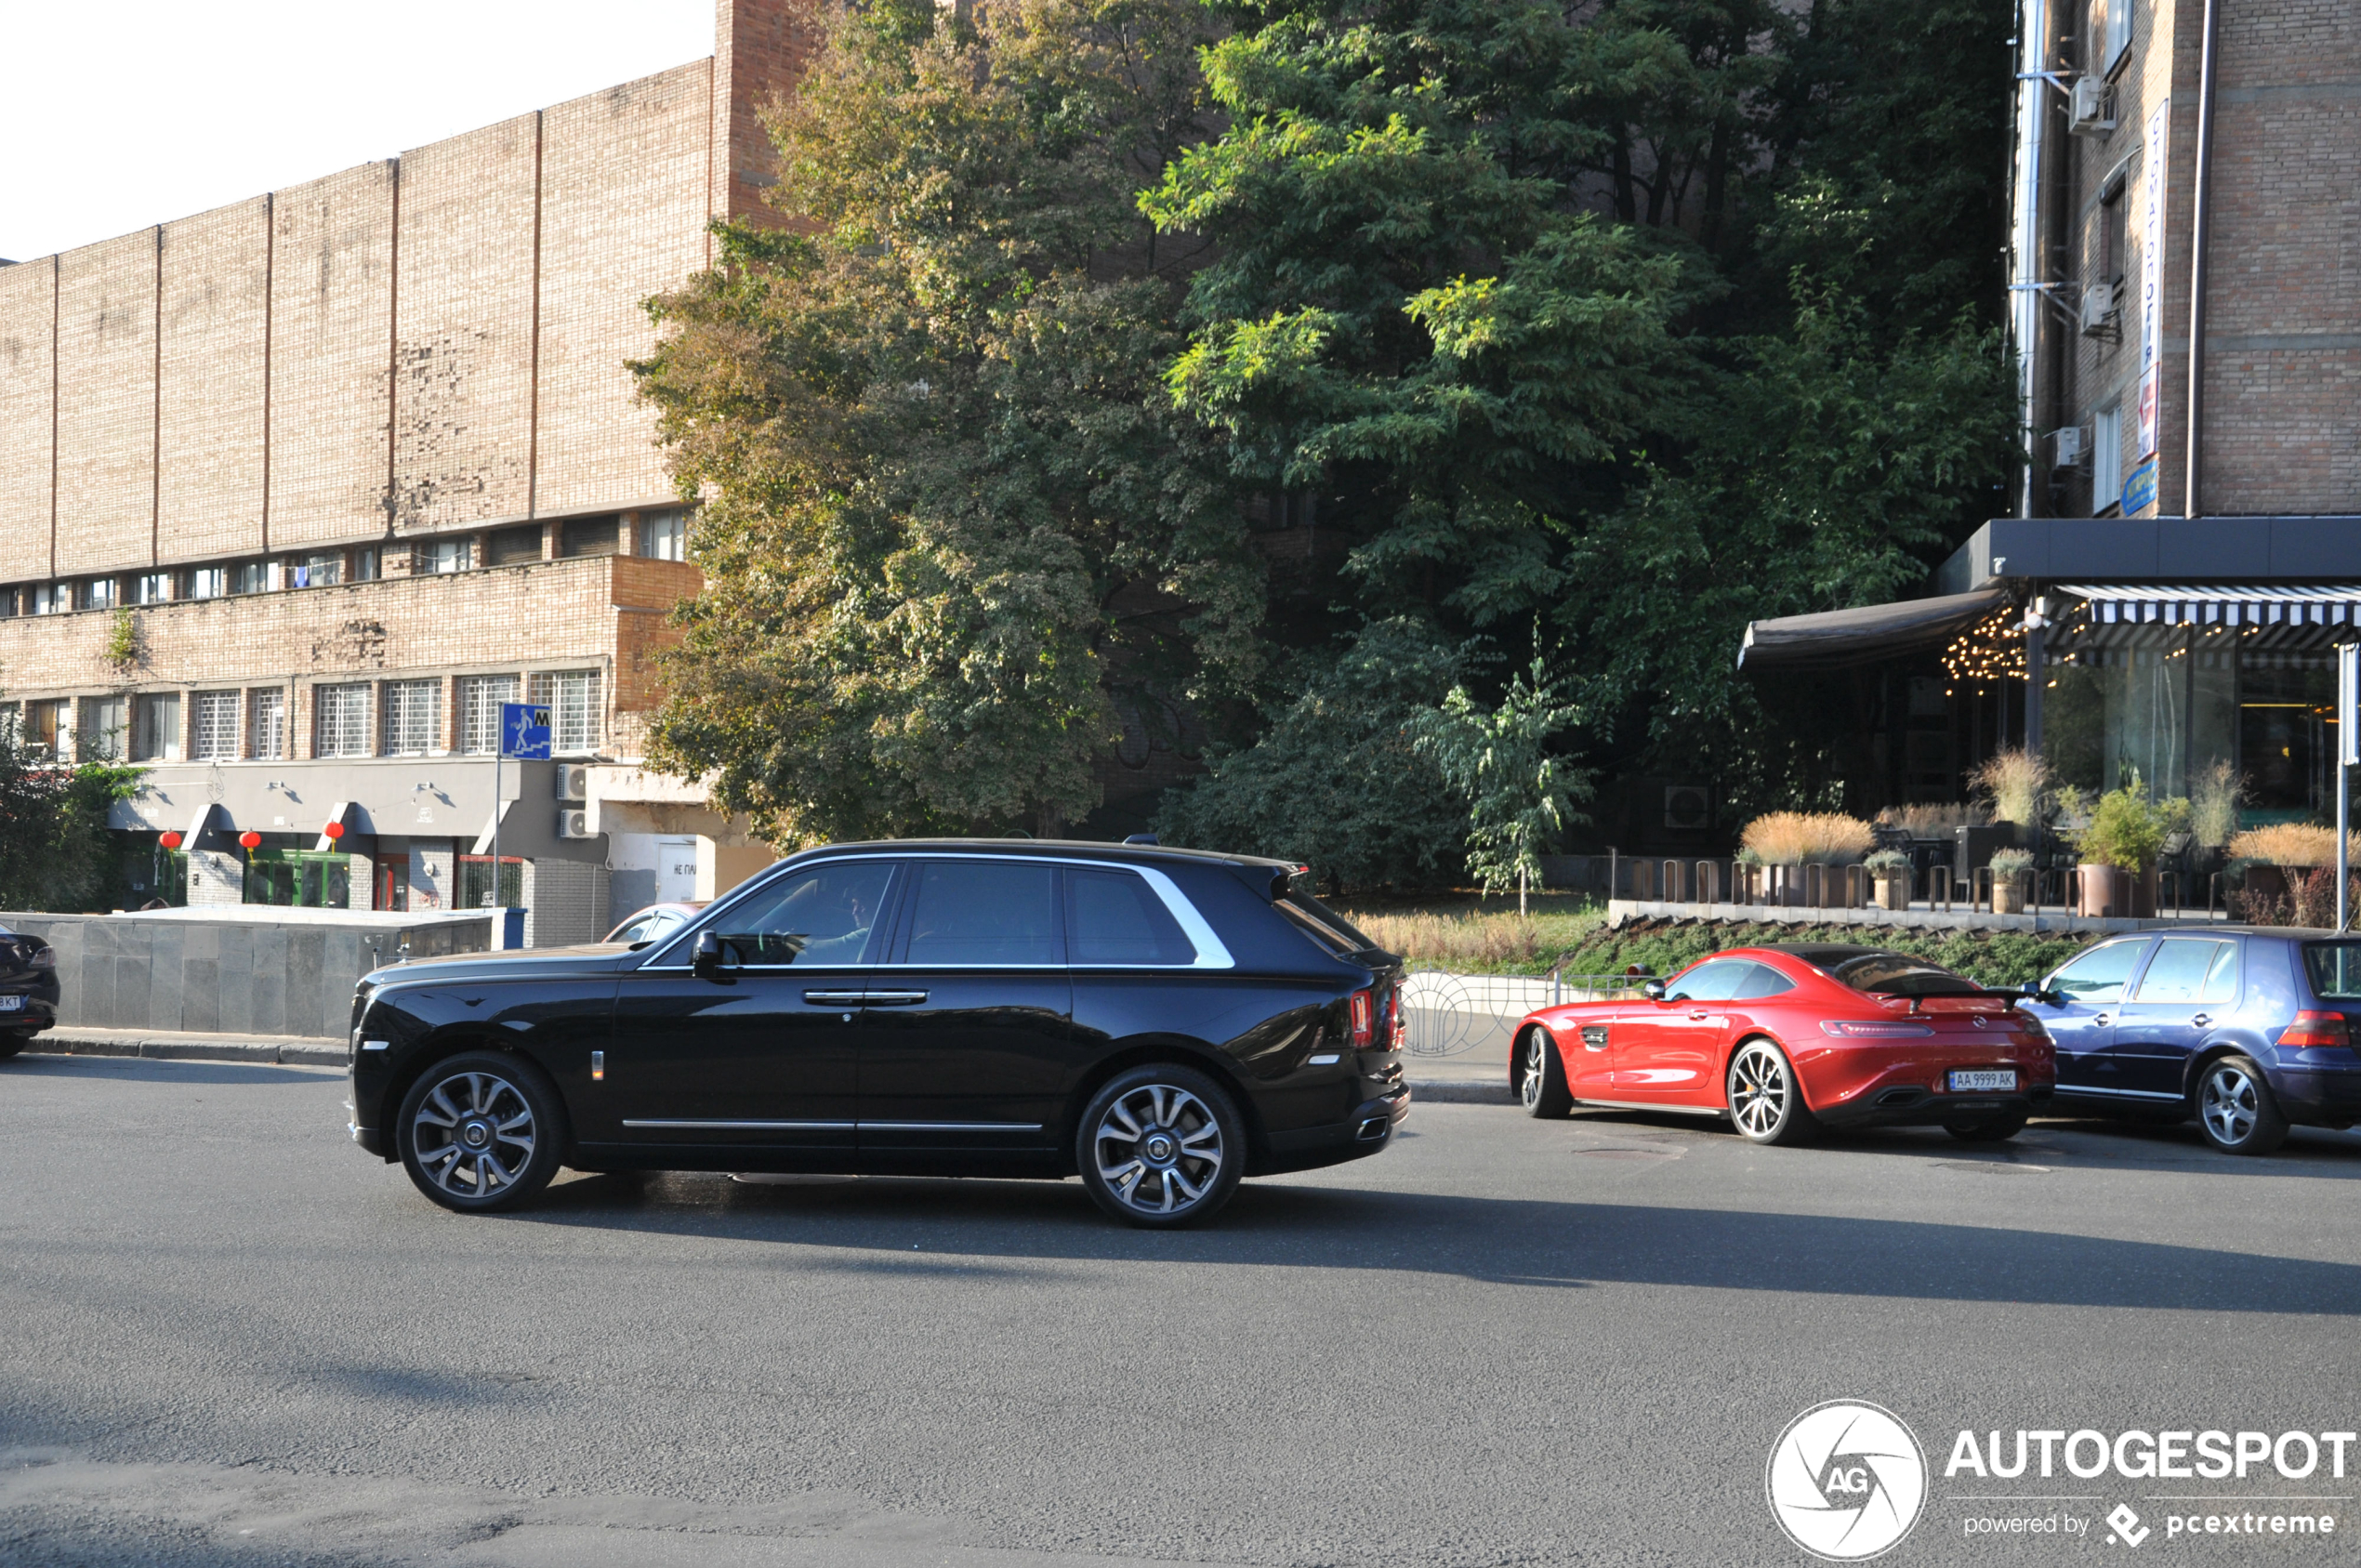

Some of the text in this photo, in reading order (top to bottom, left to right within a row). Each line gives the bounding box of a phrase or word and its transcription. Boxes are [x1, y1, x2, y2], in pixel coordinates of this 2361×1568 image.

[674, 864, 683, 875] НЕ
[6, 997, 18, 1007] KT
[1957, 1073, 2013, 1087] AA 9999 AK
